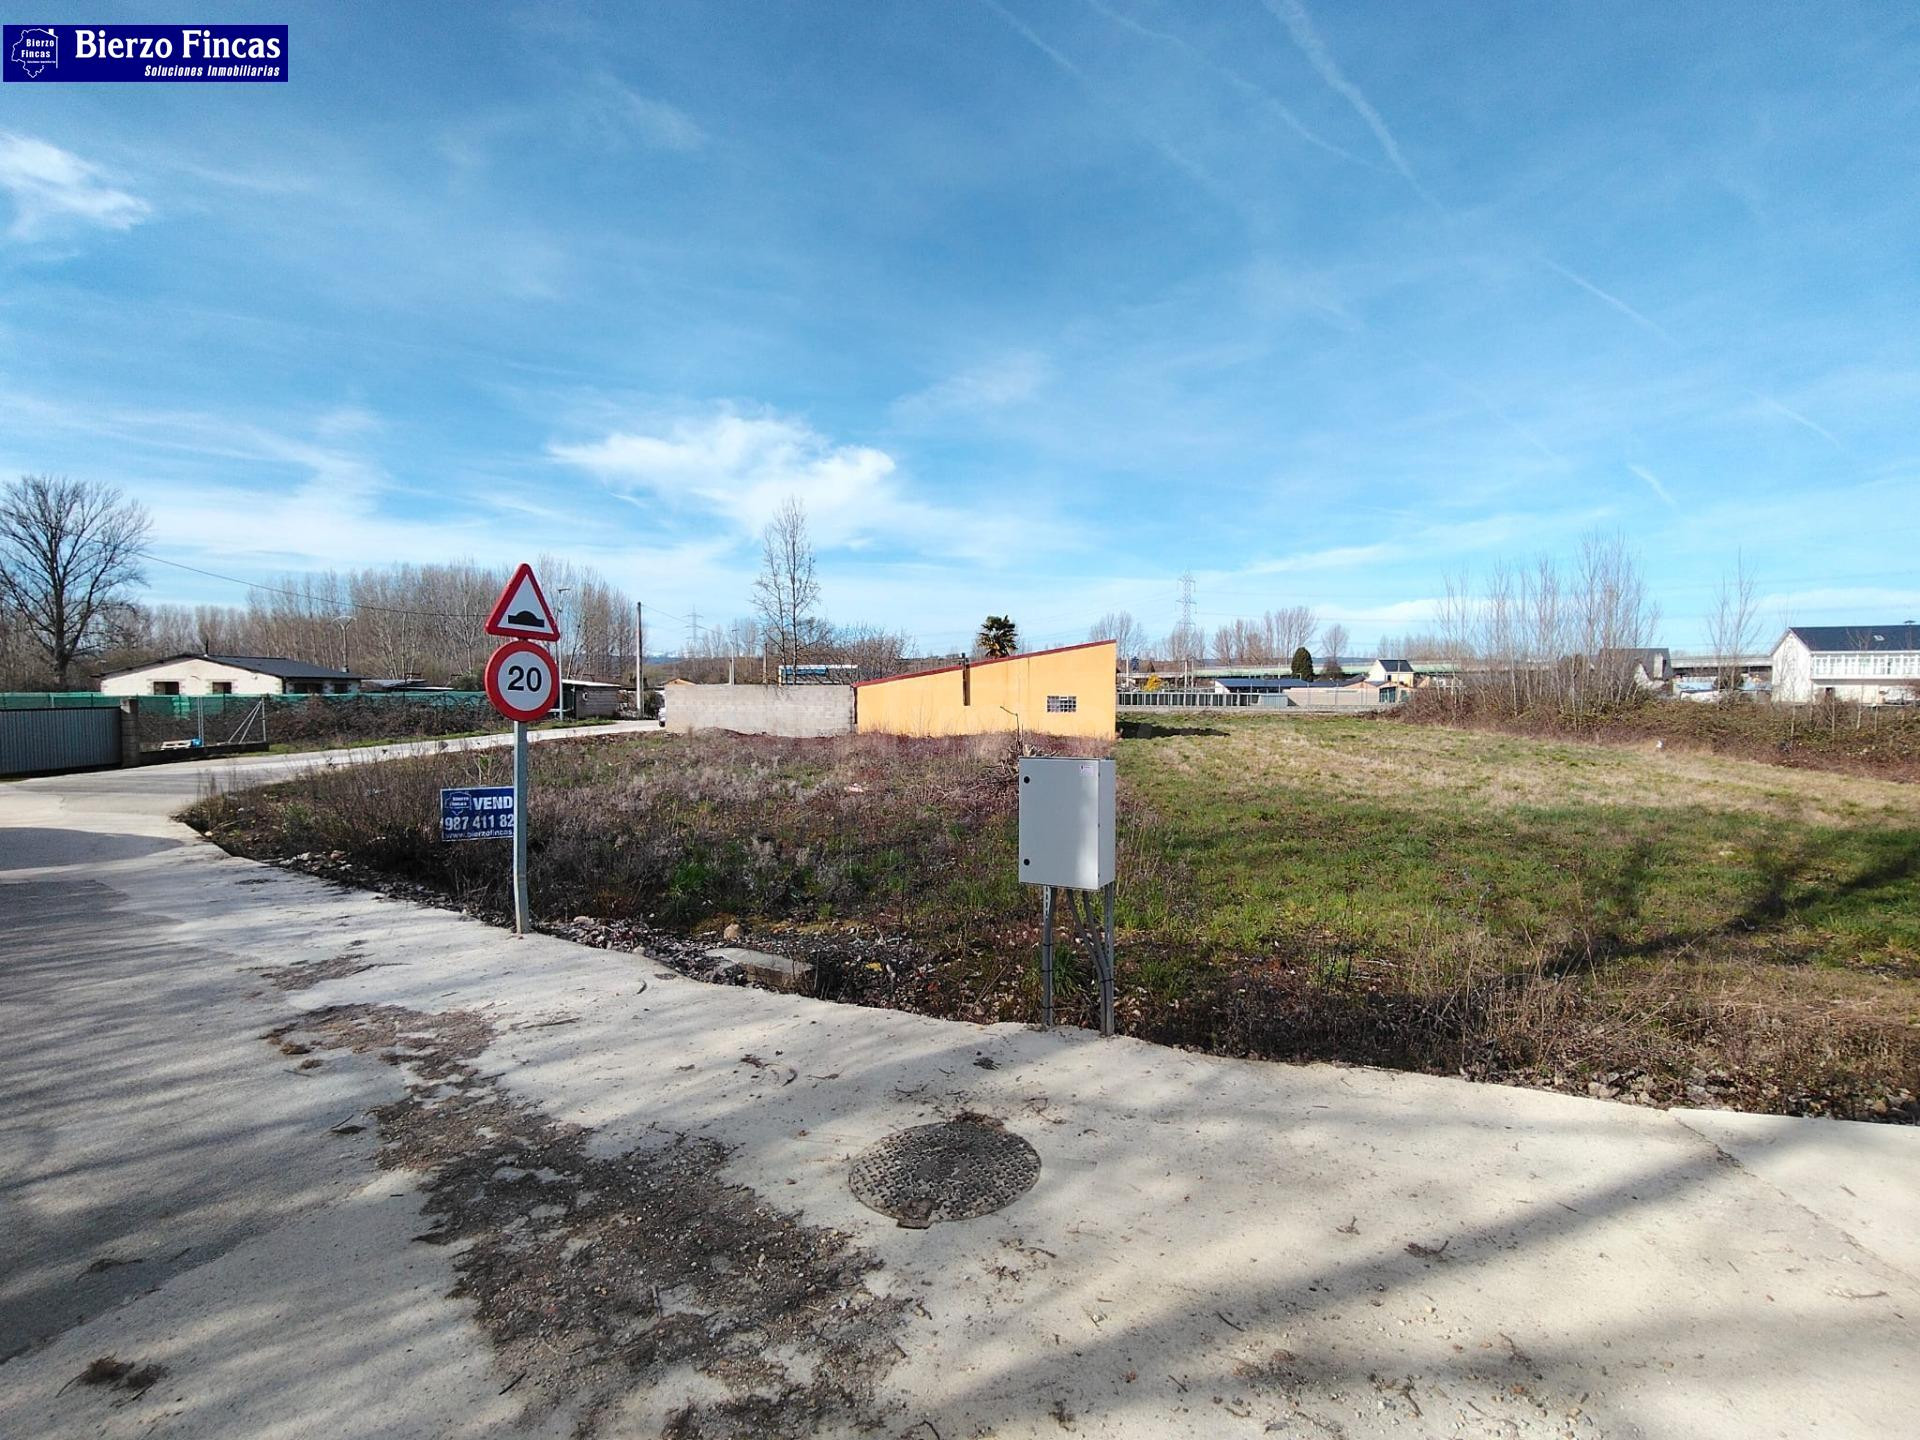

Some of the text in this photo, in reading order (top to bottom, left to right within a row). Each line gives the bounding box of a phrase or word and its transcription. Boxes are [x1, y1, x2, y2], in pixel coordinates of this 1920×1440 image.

[507, 665, 542, 692] 20
[444, 816, 469, 831] 987
[472, 815, 494, 829] 411
